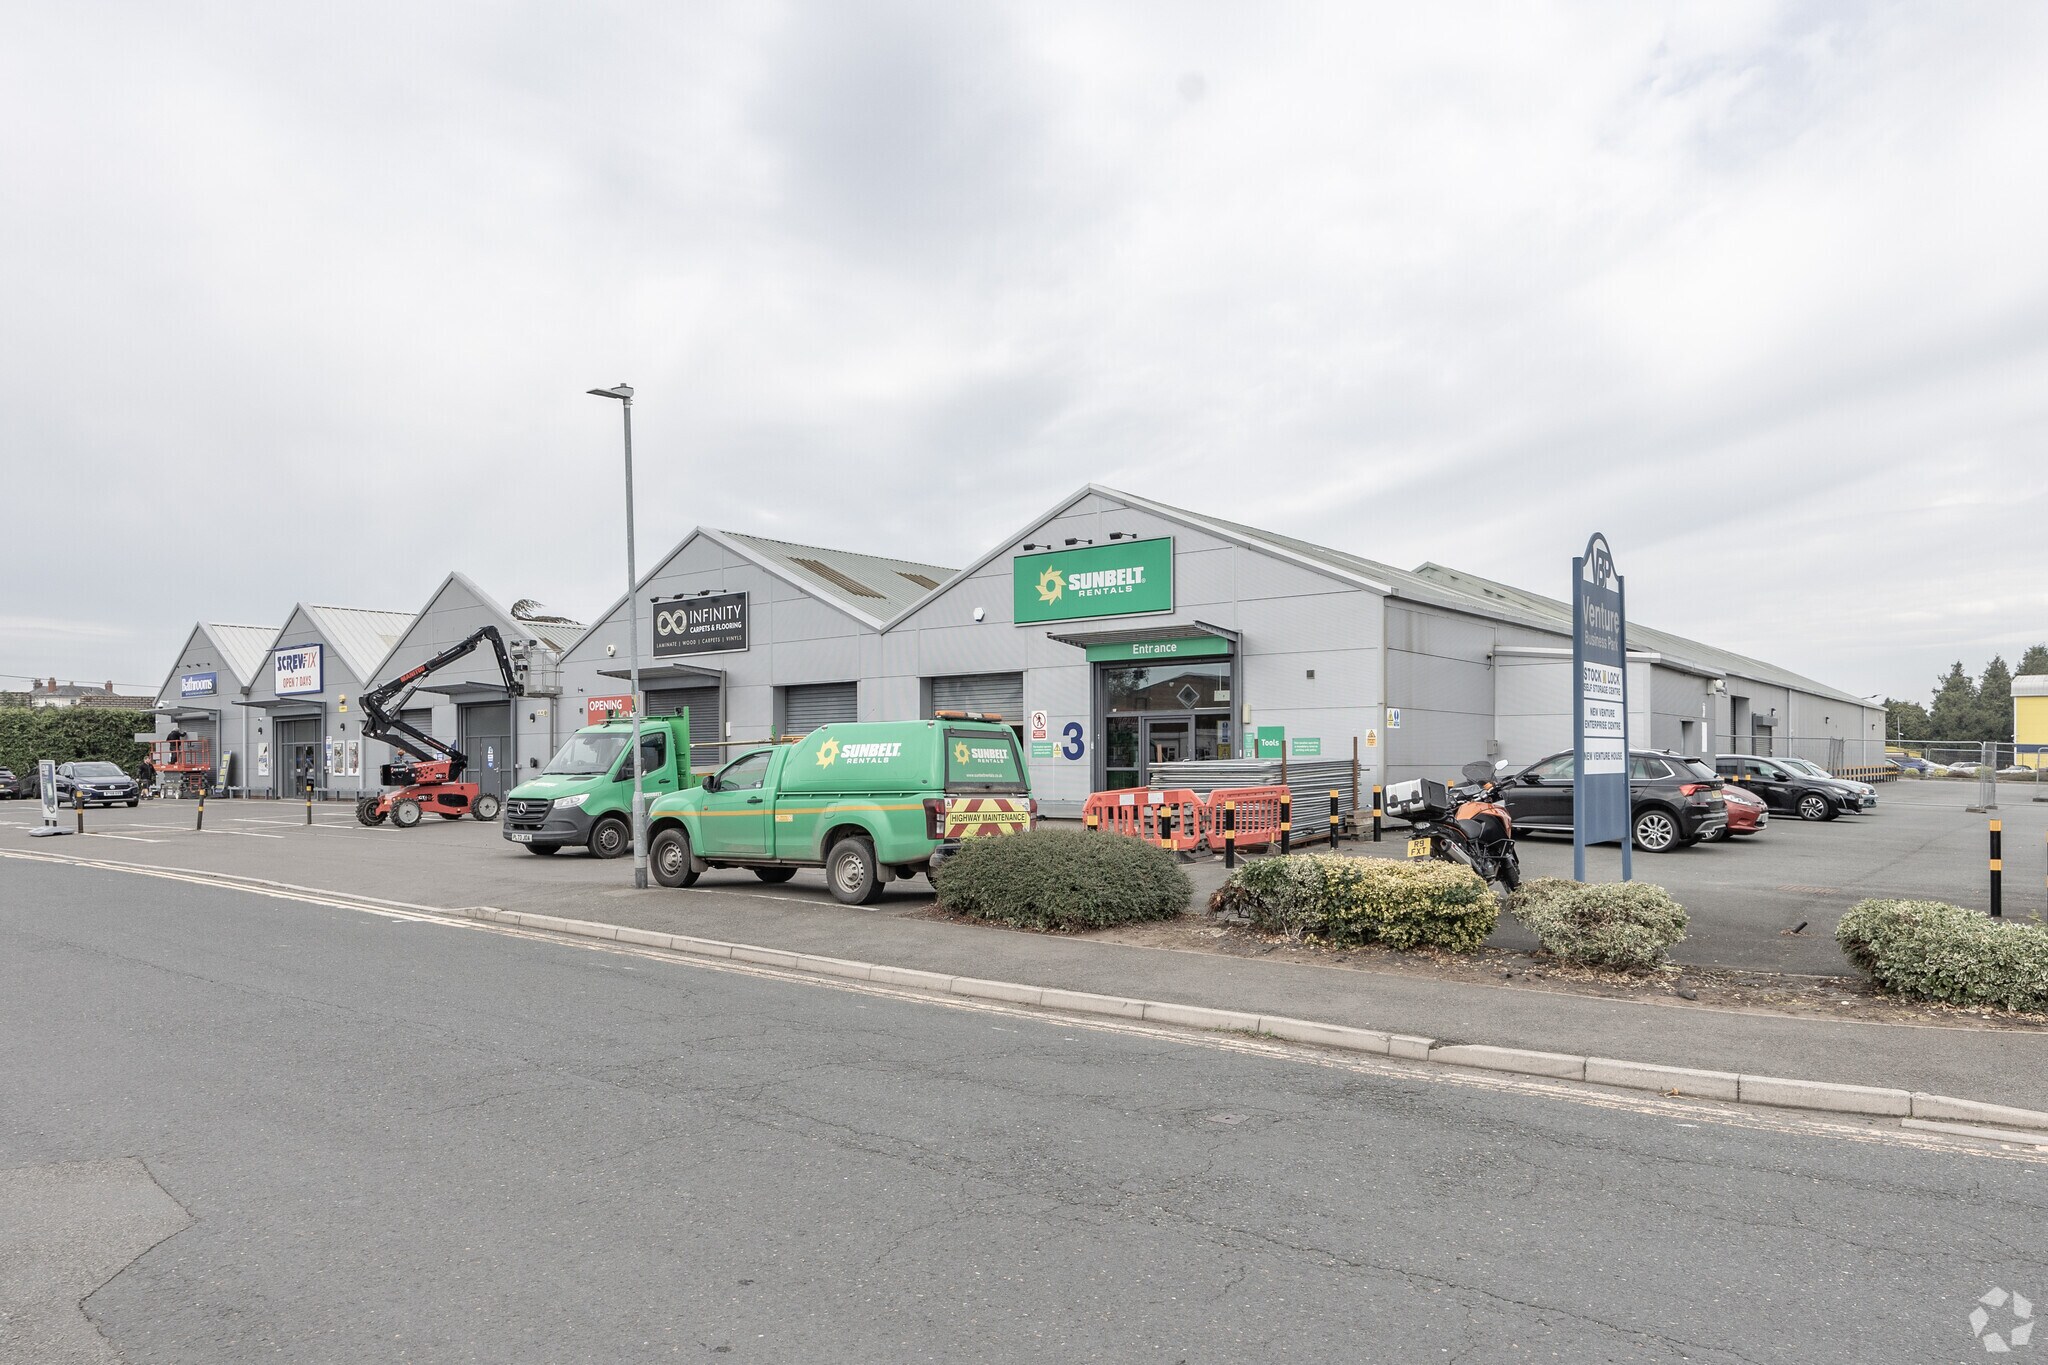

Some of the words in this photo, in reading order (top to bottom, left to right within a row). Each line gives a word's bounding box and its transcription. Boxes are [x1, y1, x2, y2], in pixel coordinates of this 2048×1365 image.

[1068, 566, 1144, 591] SUNBELT
[1078, 585, 1133, 597] RENTALS
[689, 604, 742, 624] INFINITY
[1583, 596, 1619, 634] Venture
[689, 625, 711, 634] CARPETS
[711, 623, 716, 631] &
[715, 621, 742, 631] FLOORING
[656, 641, 677, 649] LAMINATE
[1585, 631, 1607, 649] Business
[1607, 635, 1619, 653] Park
[1132, 643, 1178, 655] Entrance
[400, 665, 426, 683] MANITOU
[1583, 666, 1602, 683] STOCK
[1607, 671, 1620, 685] LOCK
[181, 677, 213, 692] Bathrooms
[283, 678, 294, 688] OPEN
[296, 677, 299, 687] 7
[299, 675, 312, 686] DAYS
[1583, 683, 1592, 692] SELF
[1593, 684, 1608, 695] STORAGE
[1608, 686, 1621, 696] CENTRE
[589, 699, 622, 711] OPENING
[1590, 707, 1598, 717] NEW
[1599, 708, 1615, 718] VENTURE
[1584, 720, 1607, 730] ENTERPRISE
[1607, 721, 1621, 731] CENTRE
[1062, 721, 1085, 761] 3
[1261, 738, 1279, 747] Tools
[840, 743, 902, 758] SUNBELT
[971, 748, 1008, 760] SUNBELT
[1583, 752, 1592, 761] NEW
[1593, 752, 1610, 761] VENTURE
[1610, 752, 1623, 761] HOUSE
[951, 813, 980, 822] HIGHWAY
[1411, 847, 1425, 855] FXT
